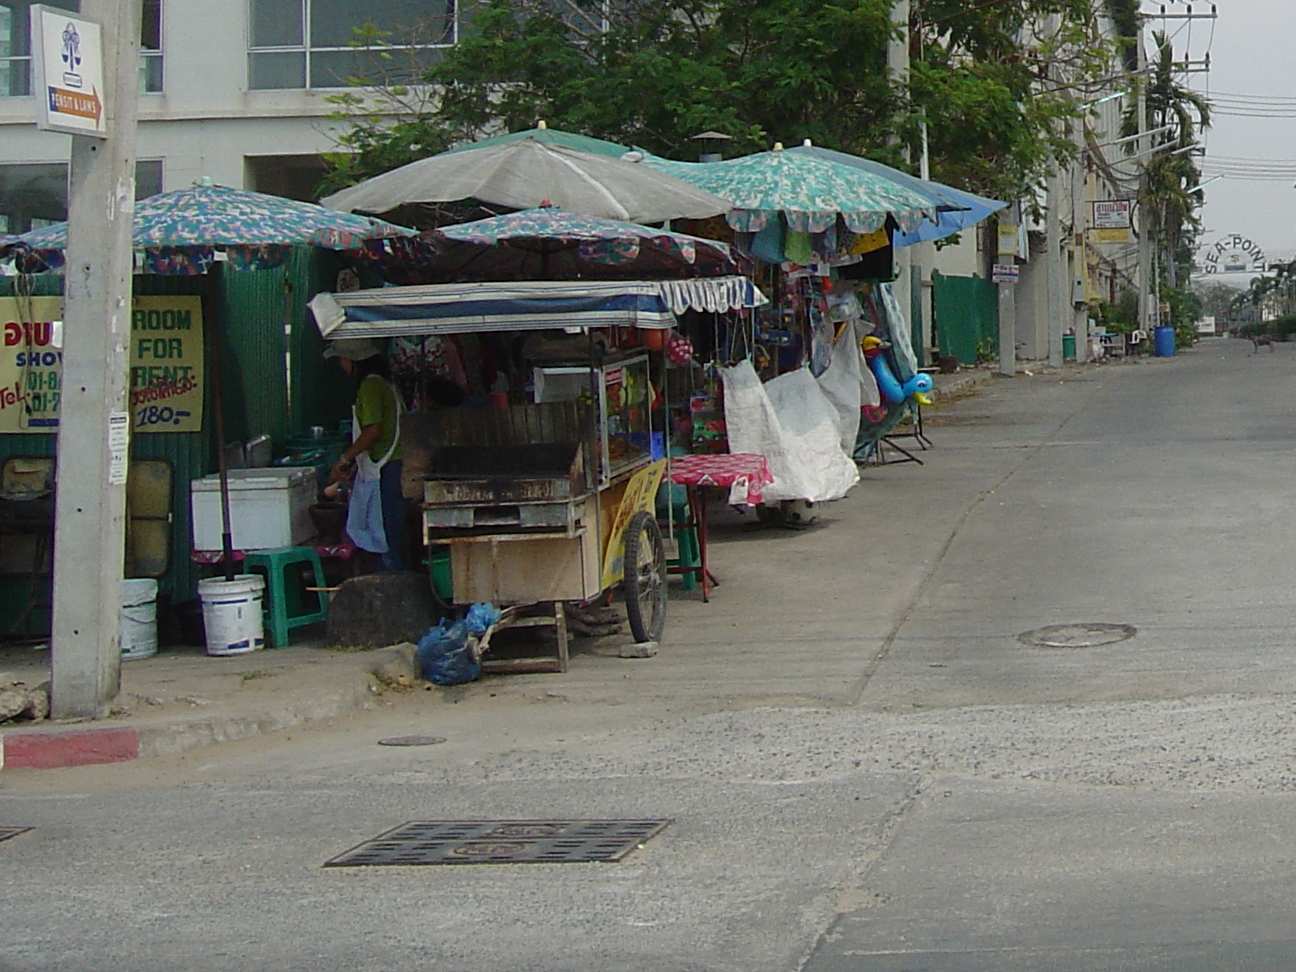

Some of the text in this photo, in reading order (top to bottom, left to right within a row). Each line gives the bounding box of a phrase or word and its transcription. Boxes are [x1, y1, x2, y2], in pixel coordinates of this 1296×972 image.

[1205, 236, 1266, 274] SEA-POINT
[132, 309, 191, 330] ROOM
[137, 338, 183, 359] FOR
[132, 366, 193, 387] RENT
